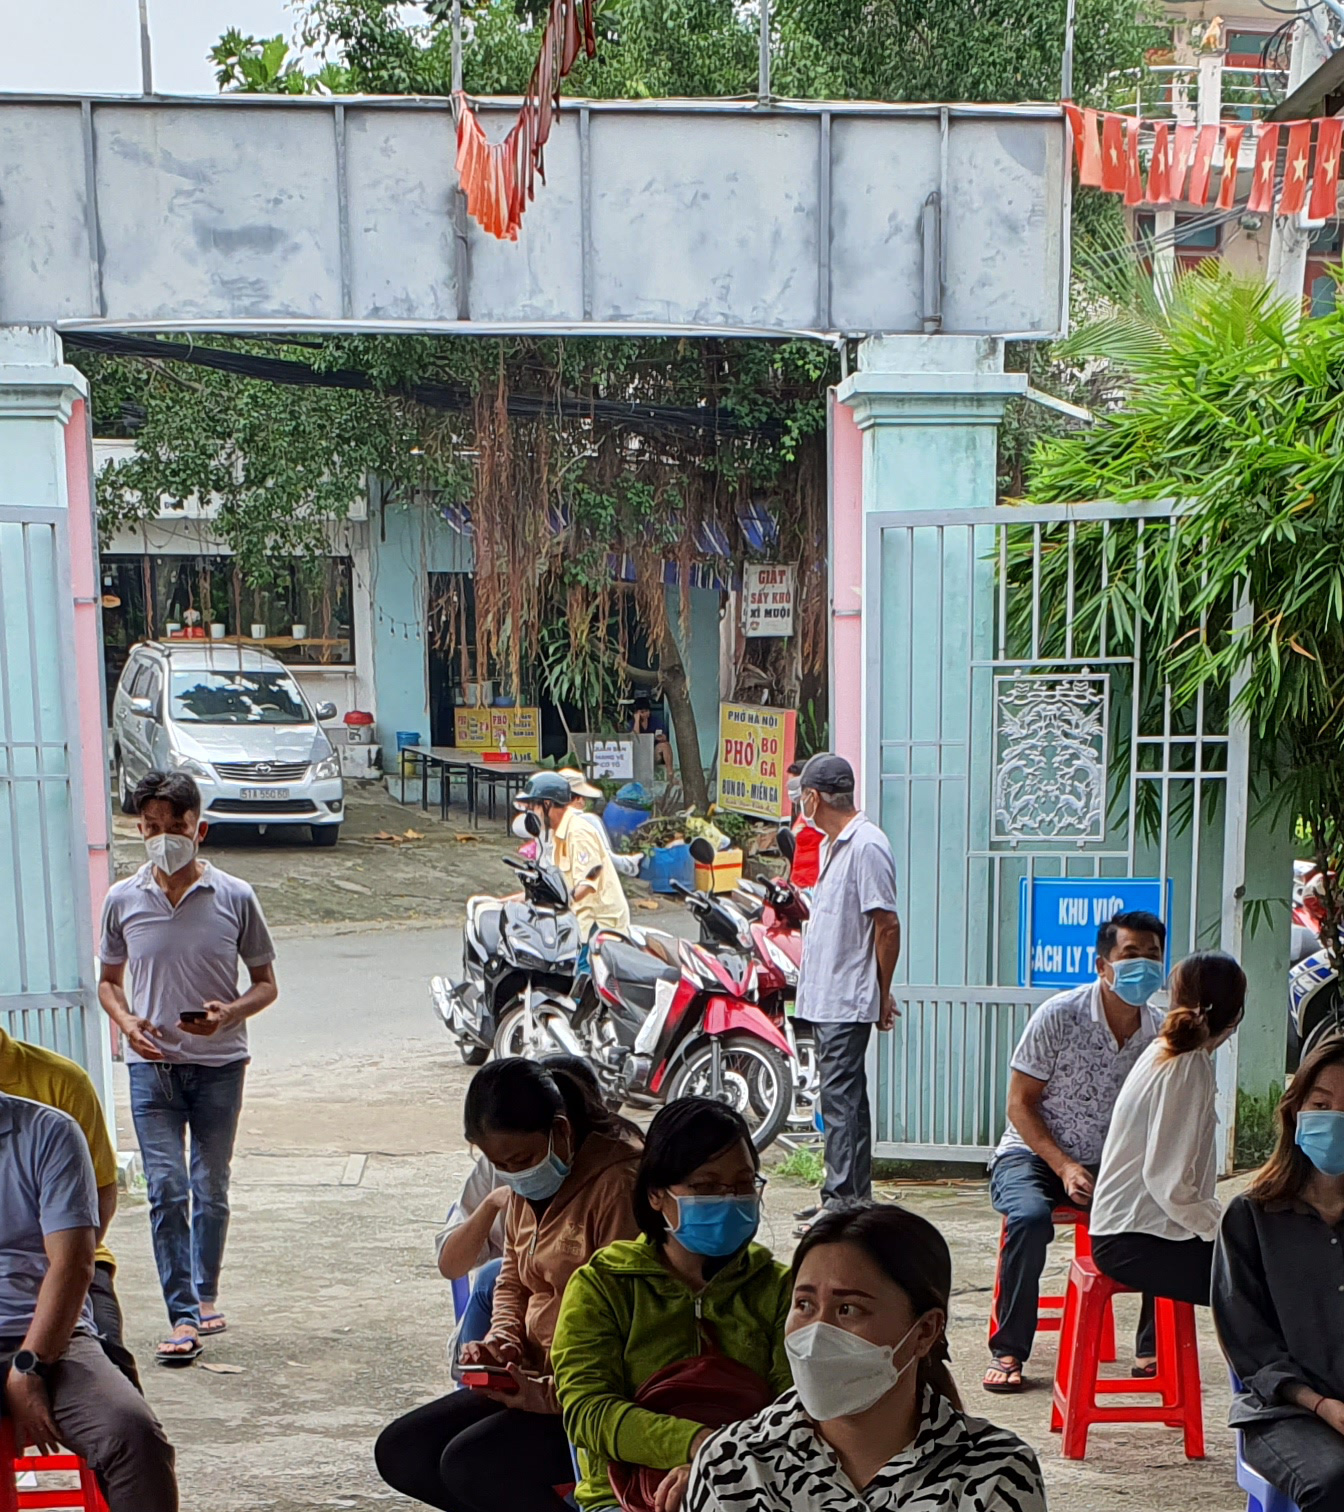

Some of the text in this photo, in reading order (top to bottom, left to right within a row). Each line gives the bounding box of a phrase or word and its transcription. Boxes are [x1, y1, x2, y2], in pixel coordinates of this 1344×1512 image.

[724, 731, 755, 766] PHỞ
[760, 759, 777, 778] GÀ
[1059, 897, 1088, 926] KHU
[1066, 946, 1083, 973] LY
